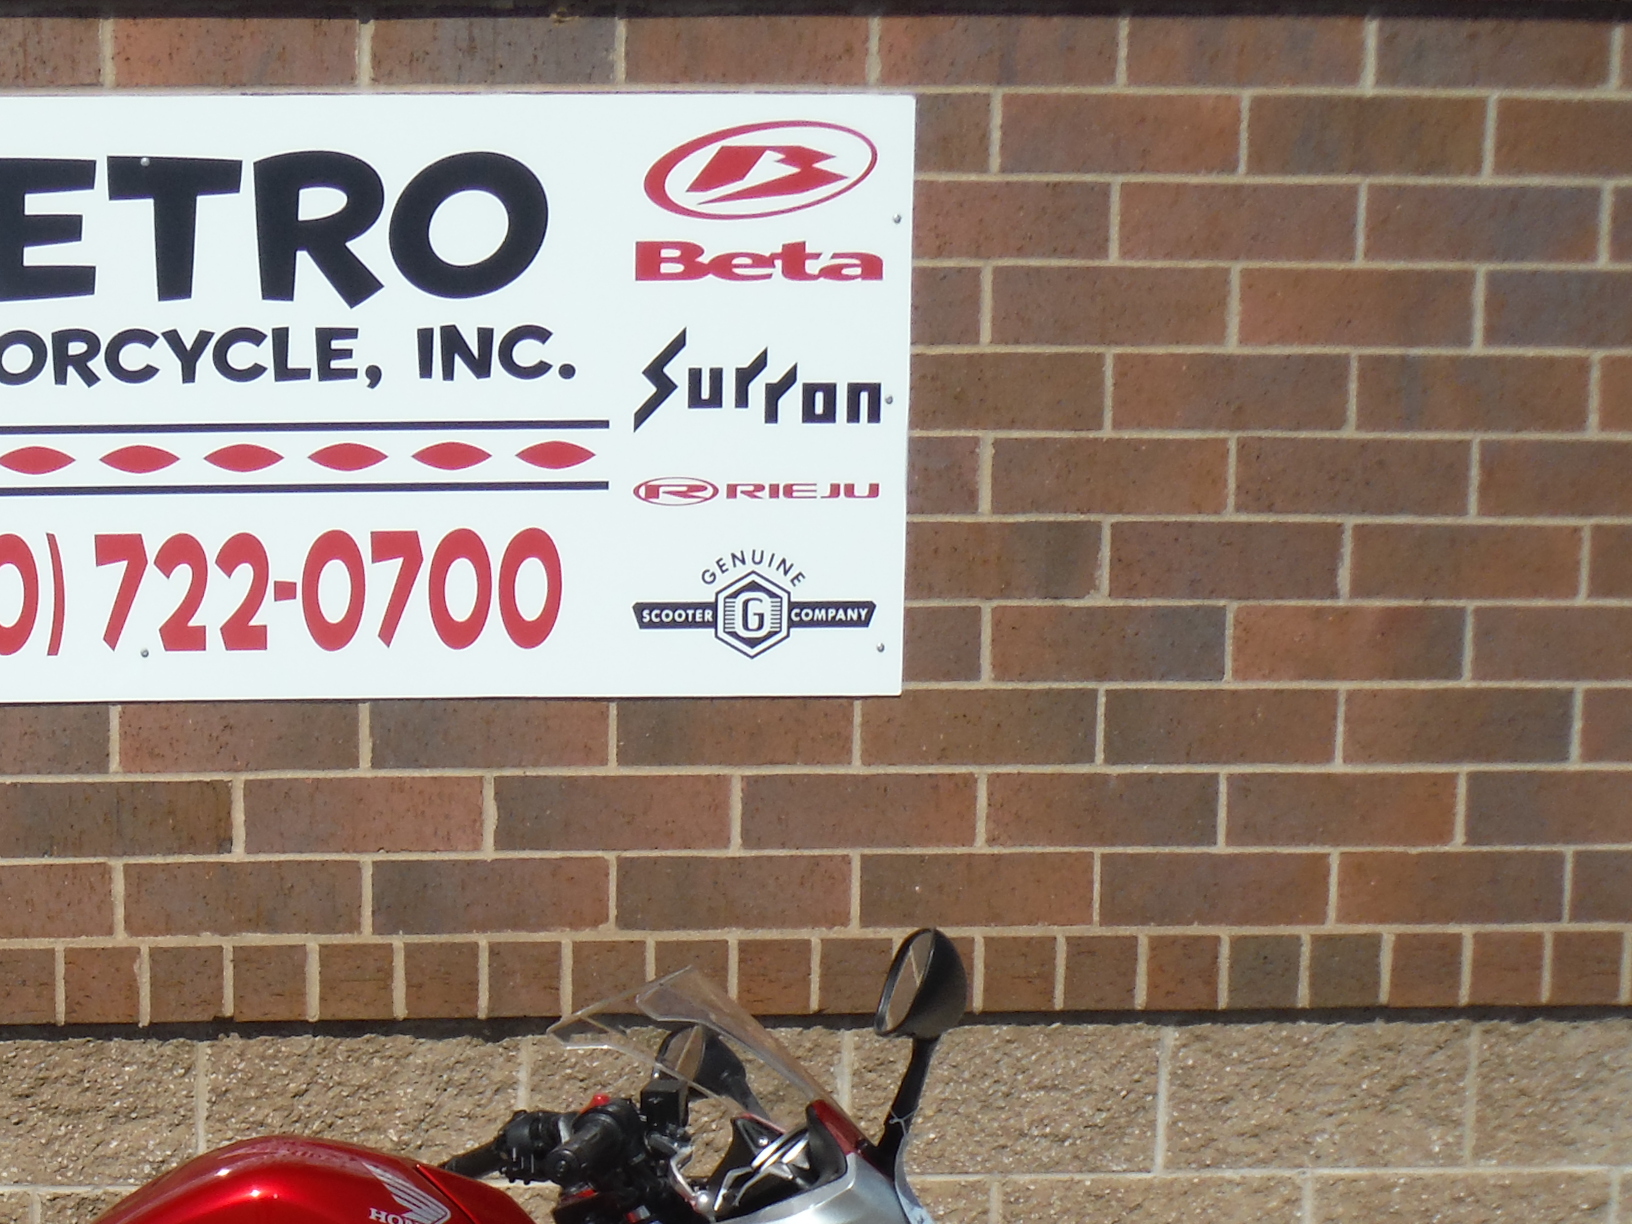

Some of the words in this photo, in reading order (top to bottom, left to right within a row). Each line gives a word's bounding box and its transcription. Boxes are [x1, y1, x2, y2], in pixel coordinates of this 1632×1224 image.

[635, 240, 883, 281] Beta
[417, 324, 576, 382] INC.
[633, 326, 881, 433] Surron
[726, 483, 880, 499] RIEJU
[701, 549, 805, 587] GENUINE
[95, 527, 563, 652] 722-0700
[641, 609, 713, 623] SCOOTER
[742, 598, 765, 632] G
[790, 606, 868, 622] COMPANY
